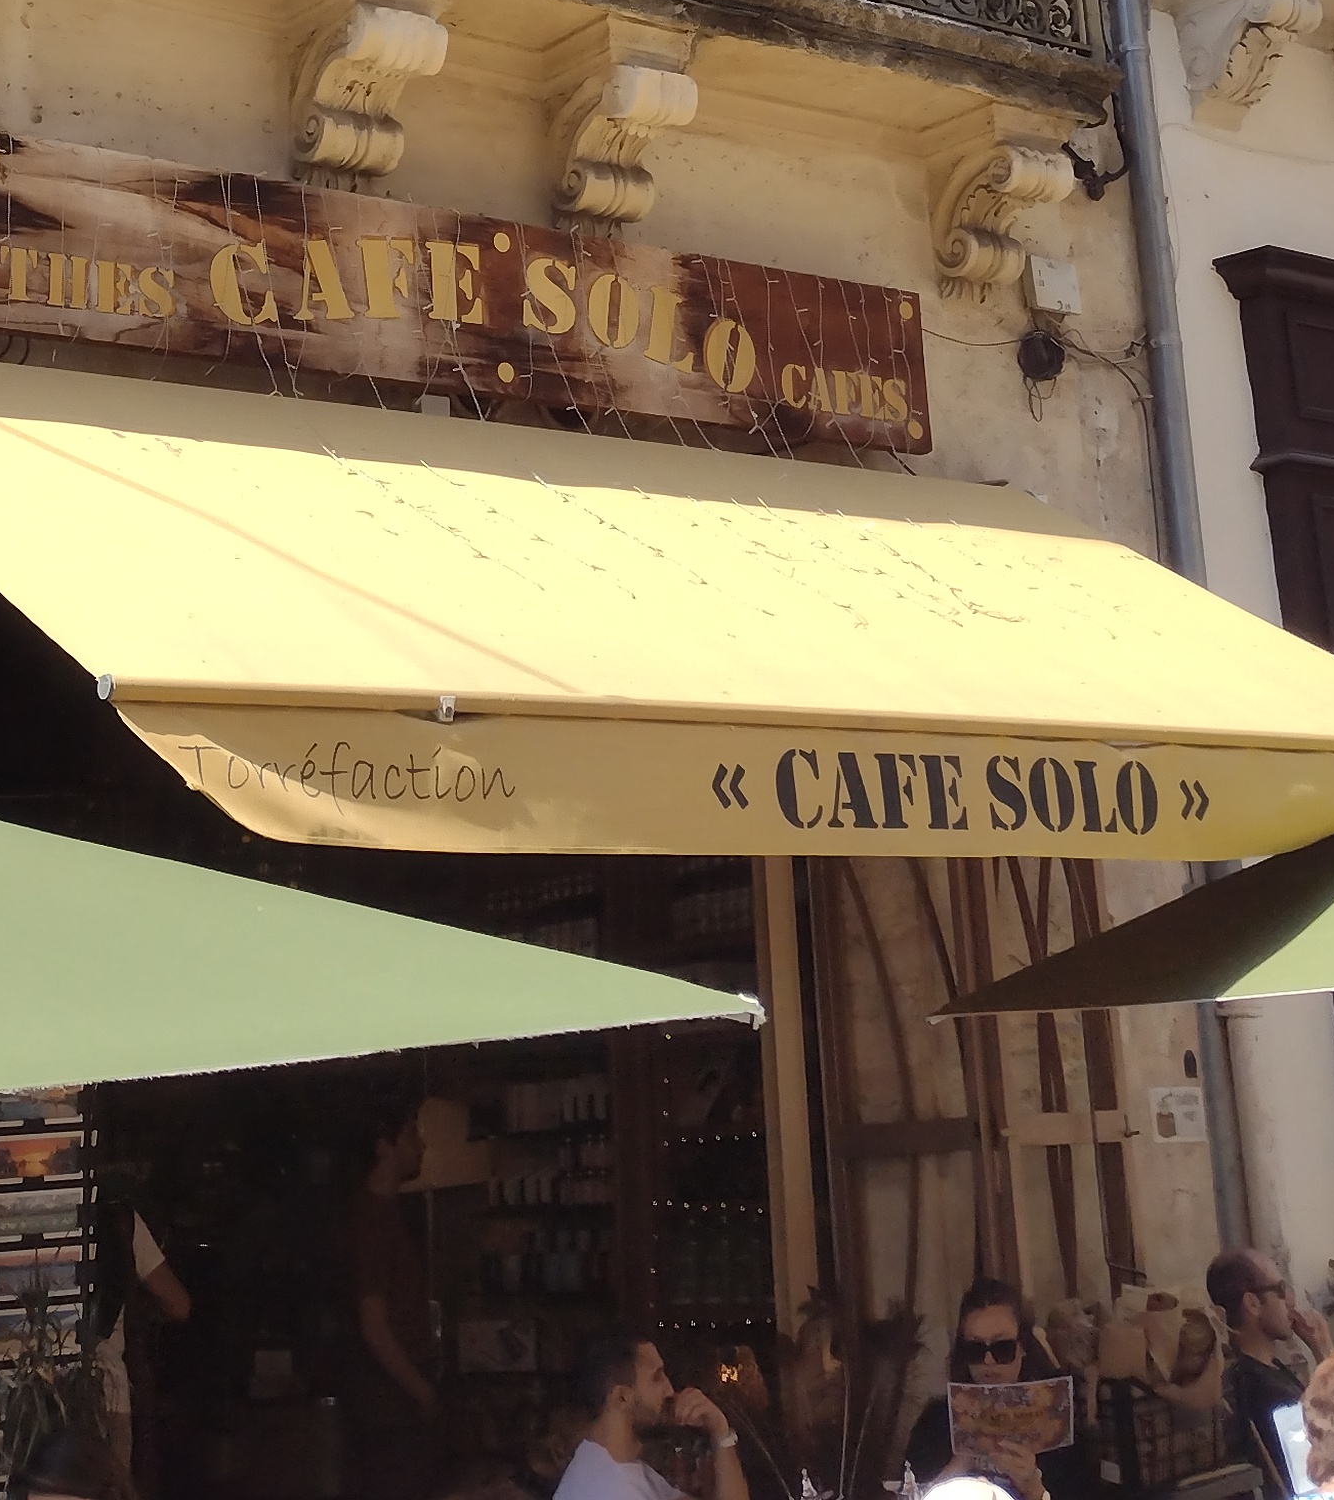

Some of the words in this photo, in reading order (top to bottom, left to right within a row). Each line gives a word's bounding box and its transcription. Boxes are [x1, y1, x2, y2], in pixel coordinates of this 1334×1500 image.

[0, 245, 175, 318] THES
[523, 256, 756, 394] SOLO
[781, 363, 909, 422] CAFES
[178, 741, 516, 816] Torréfaction
[775, 748, 969, 830] CAFE
[985, 754, 1159, 836] SOLO
